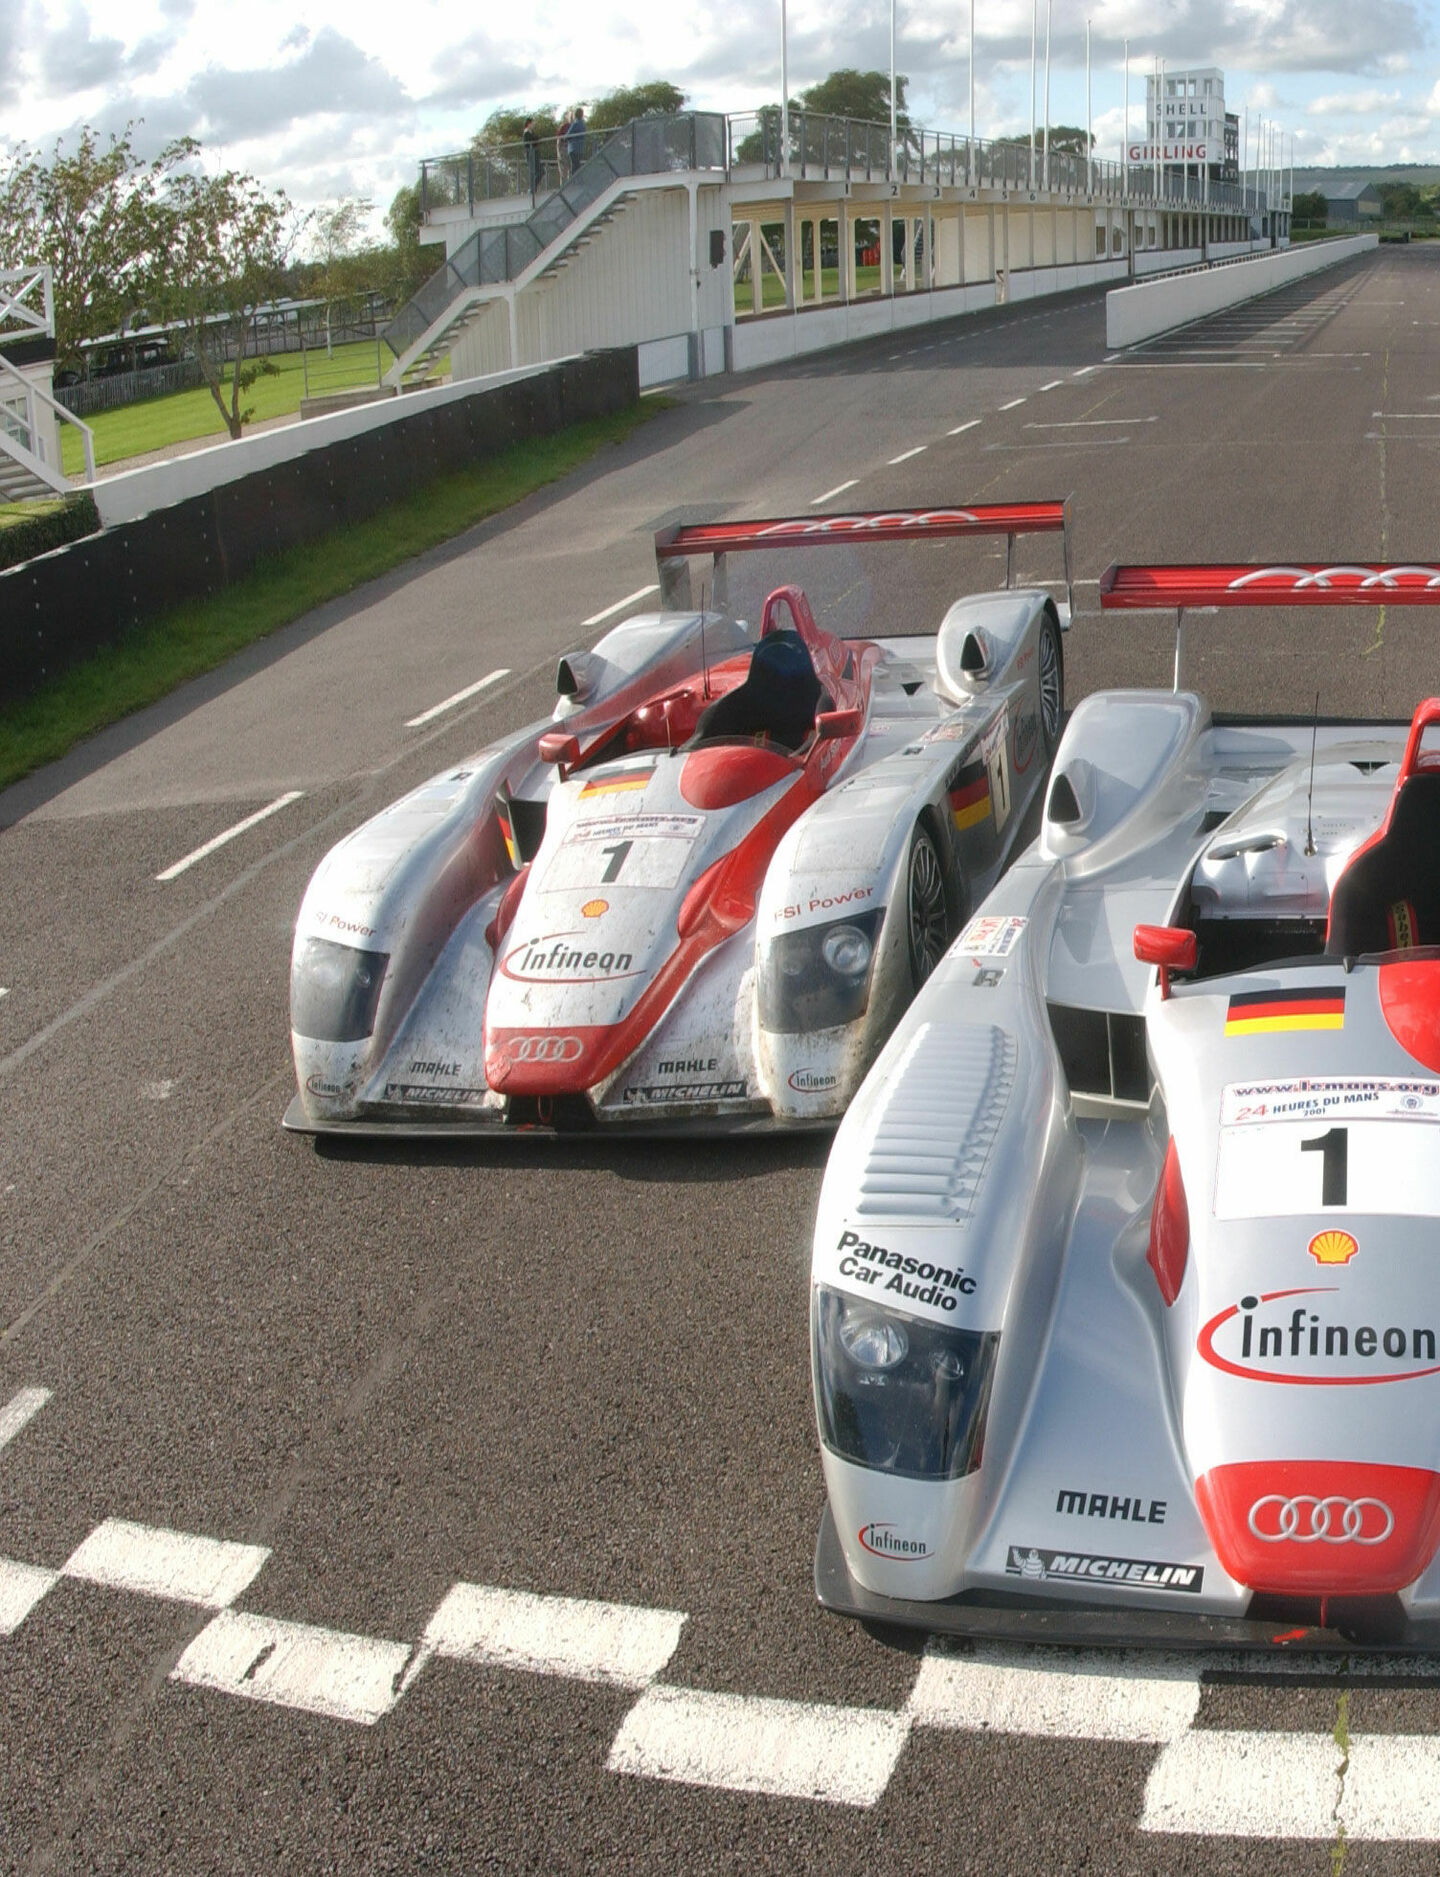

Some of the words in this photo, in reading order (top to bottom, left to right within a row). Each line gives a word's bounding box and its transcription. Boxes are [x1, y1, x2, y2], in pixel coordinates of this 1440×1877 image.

[1156, 103, 1207, 115] SHELL
[1129, 144, 1207, 160] GIRLING
[891, 186, 898, 196] 2
[933, 187, 940, 198] 3
[969, 189, 976, 198] 4
[601, 840, 634, 883] 1
[809, 887, 873, 912] Power
[411, 1061, 462, 1077] MAHLE
[658, 1058, 718, 1074] MAHLE
[405, 1087, 484, 1102] MICHELIN
[651, 1083, 743, 1099] MICHELIN
[1233, 1080, 1440, 1096] www.lemans.org
[1235, 1104, 1269, 1121] 24
[1273, 1099, 1319, 1113] HEURES
[1323, 1096, 1340, 1106] DU
[1344, 1092, 1380, 1104] MANS
[1303, 1107, 1326, 1117] 2001
[1301, 1127, 1348, 1206] 1
[837, 1230, 977, 1295] Panasonic
[839, 1256, 884, 1284] Car
[884, 1273, 957, 1311] Audio
[1055, 1490, 1167, 1524] MAHLE
[1050, 1556, 1197, 1586] MICHELIN
